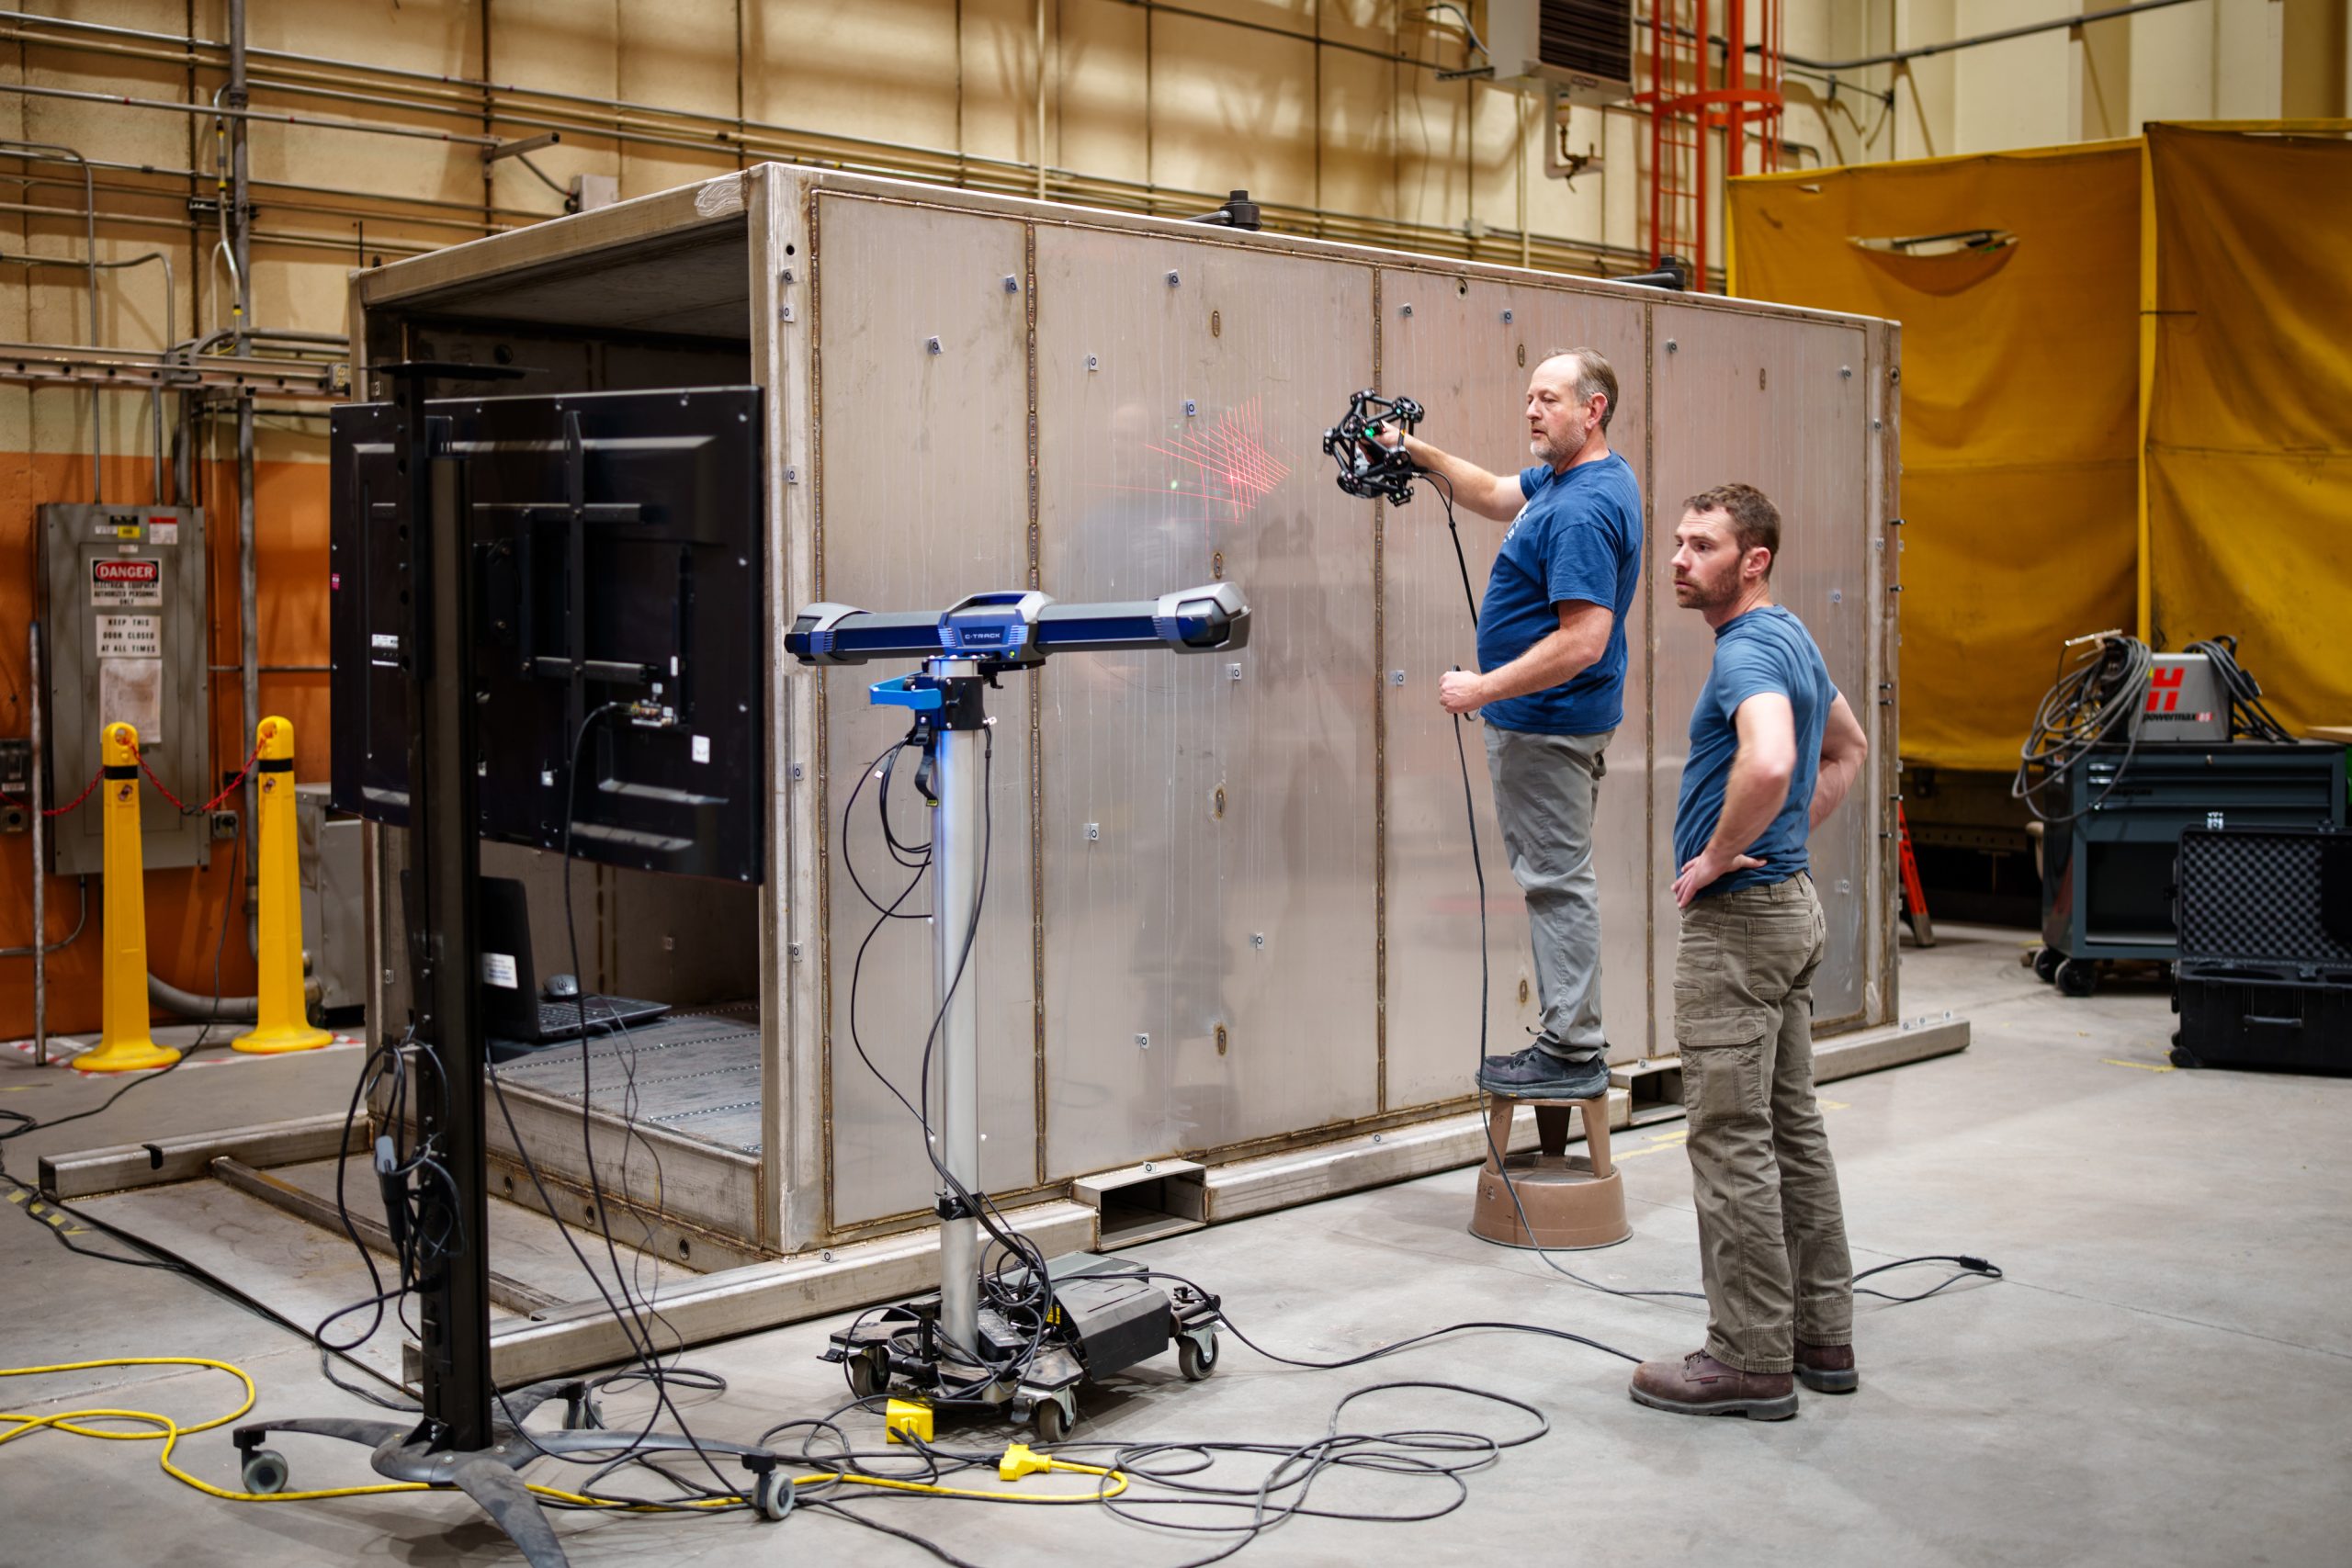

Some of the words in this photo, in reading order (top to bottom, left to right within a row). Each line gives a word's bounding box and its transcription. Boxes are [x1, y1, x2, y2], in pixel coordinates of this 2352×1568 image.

[99, 566, 153, 578] DANGER
[107, 618, 127, 626] KEEP
[132, 618, 150, 626] THIS
